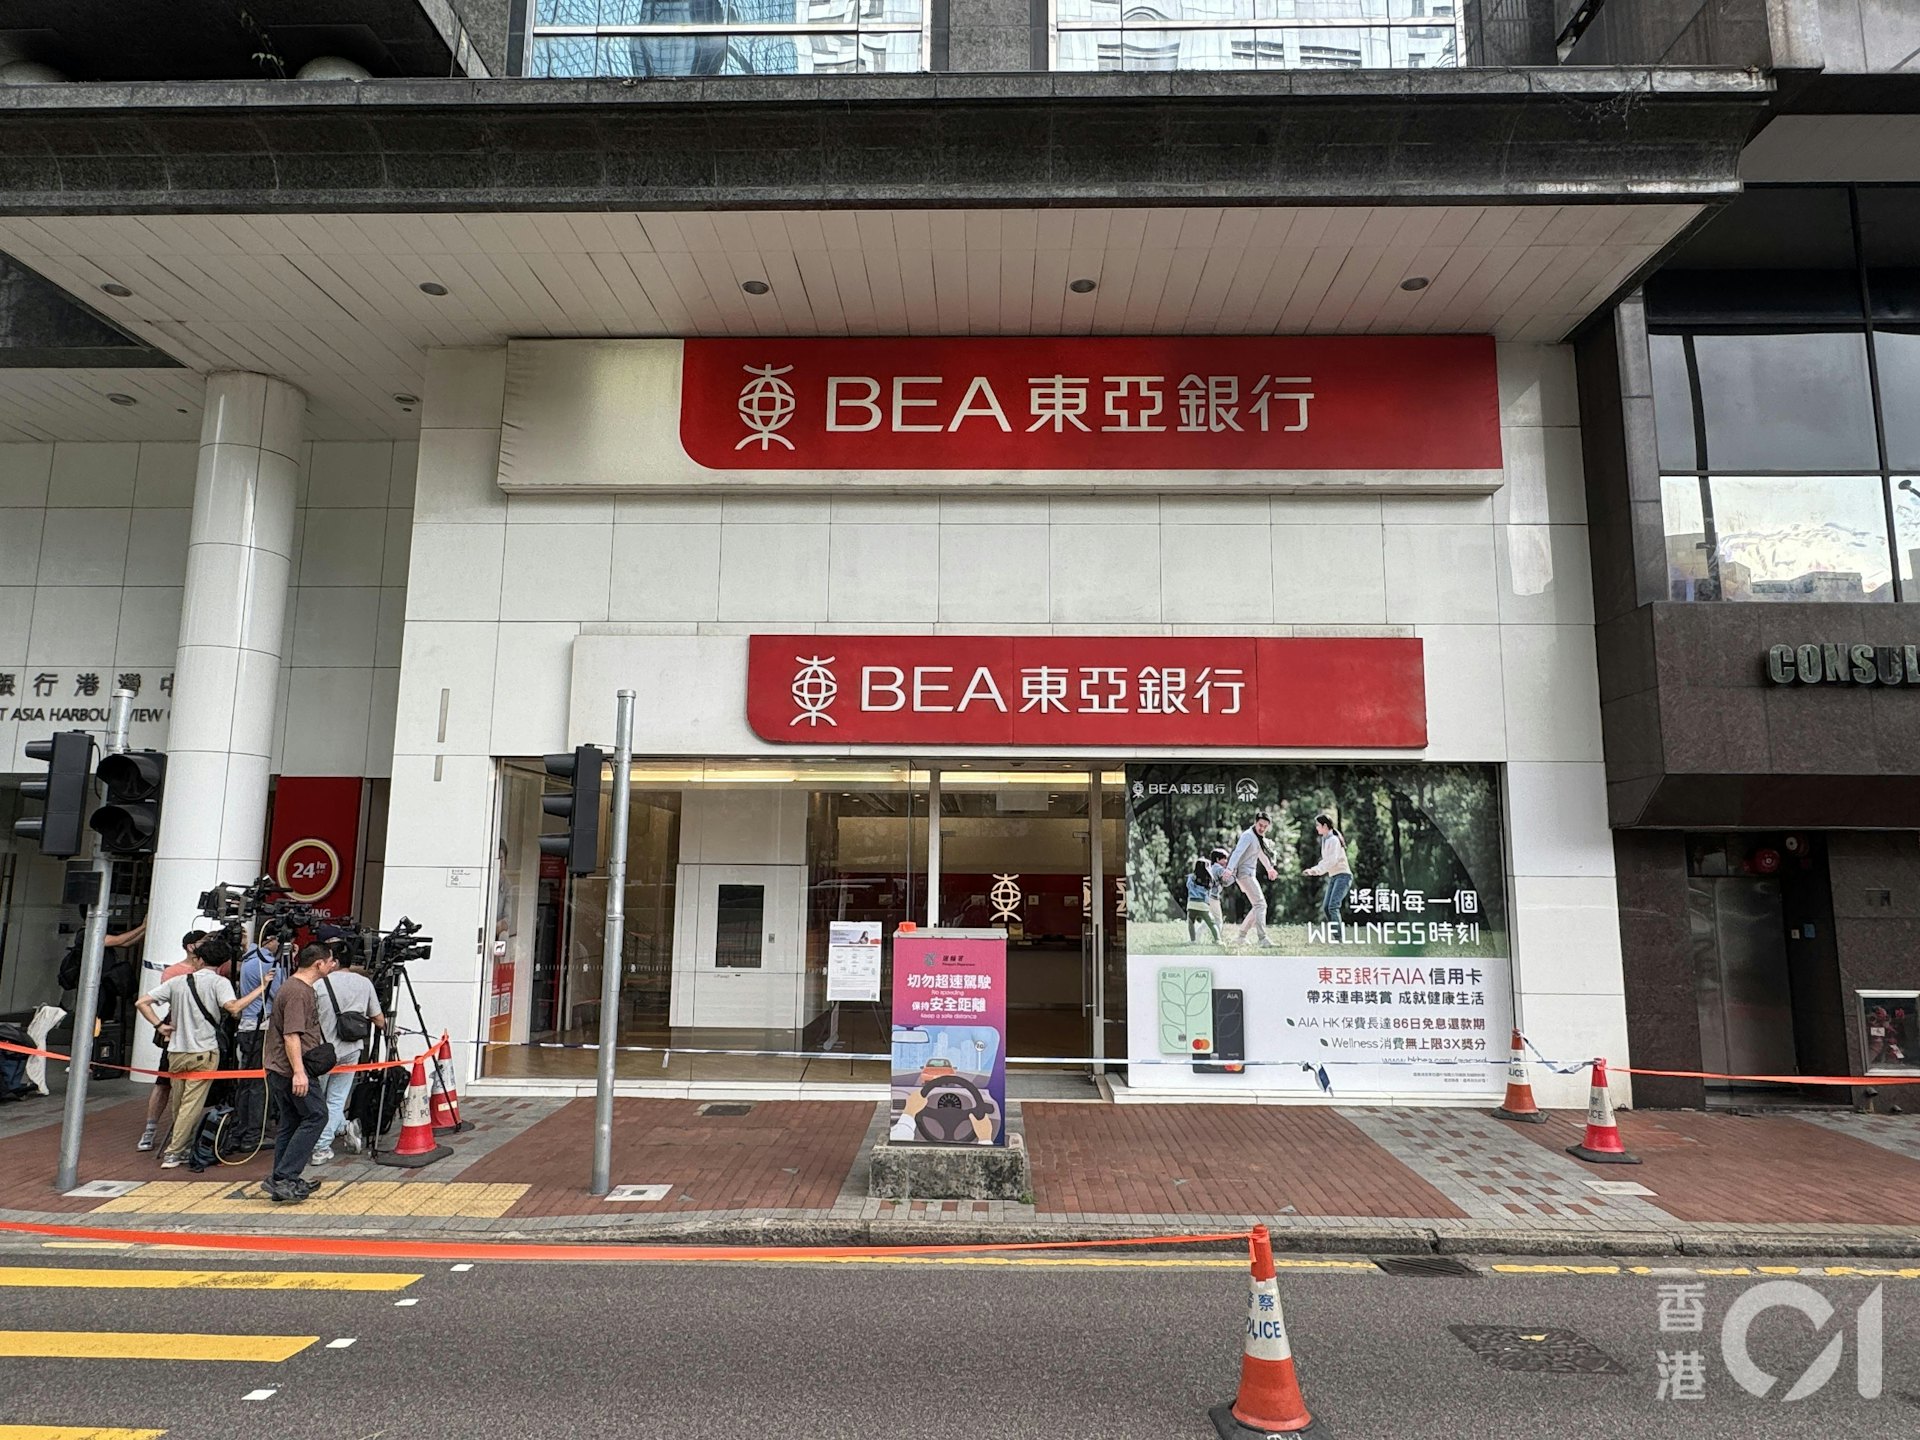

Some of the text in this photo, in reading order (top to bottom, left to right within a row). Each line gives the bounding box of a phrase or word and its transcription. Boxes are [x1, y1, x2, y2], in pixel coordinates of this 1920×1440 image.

[825, 373, 1315, 433] BEA 東亞銀行
[860, 665, 1245, 714] BEA 東亞銀行
[10, 707, 45, 722] ASIA
[49, 707, 112, 722] HARBOU
[1148, 783, 1225, 795] BEA 東亞銀行
[1350, 888, 1479, 914] 獎勵每一個
[907, 973, 992, 989] 切勿超速駕駛
[911, 997, 987, 1013] 保持安全距離
[1307, 990, 1485, 1006] 帶來連串獎賞 成就健康生活
[1297, 1018, 1319, 1028] AIA
[1508, 1067, 1525, 1078] LICE
[1247, 1317, 1282, 1340] OLICE
